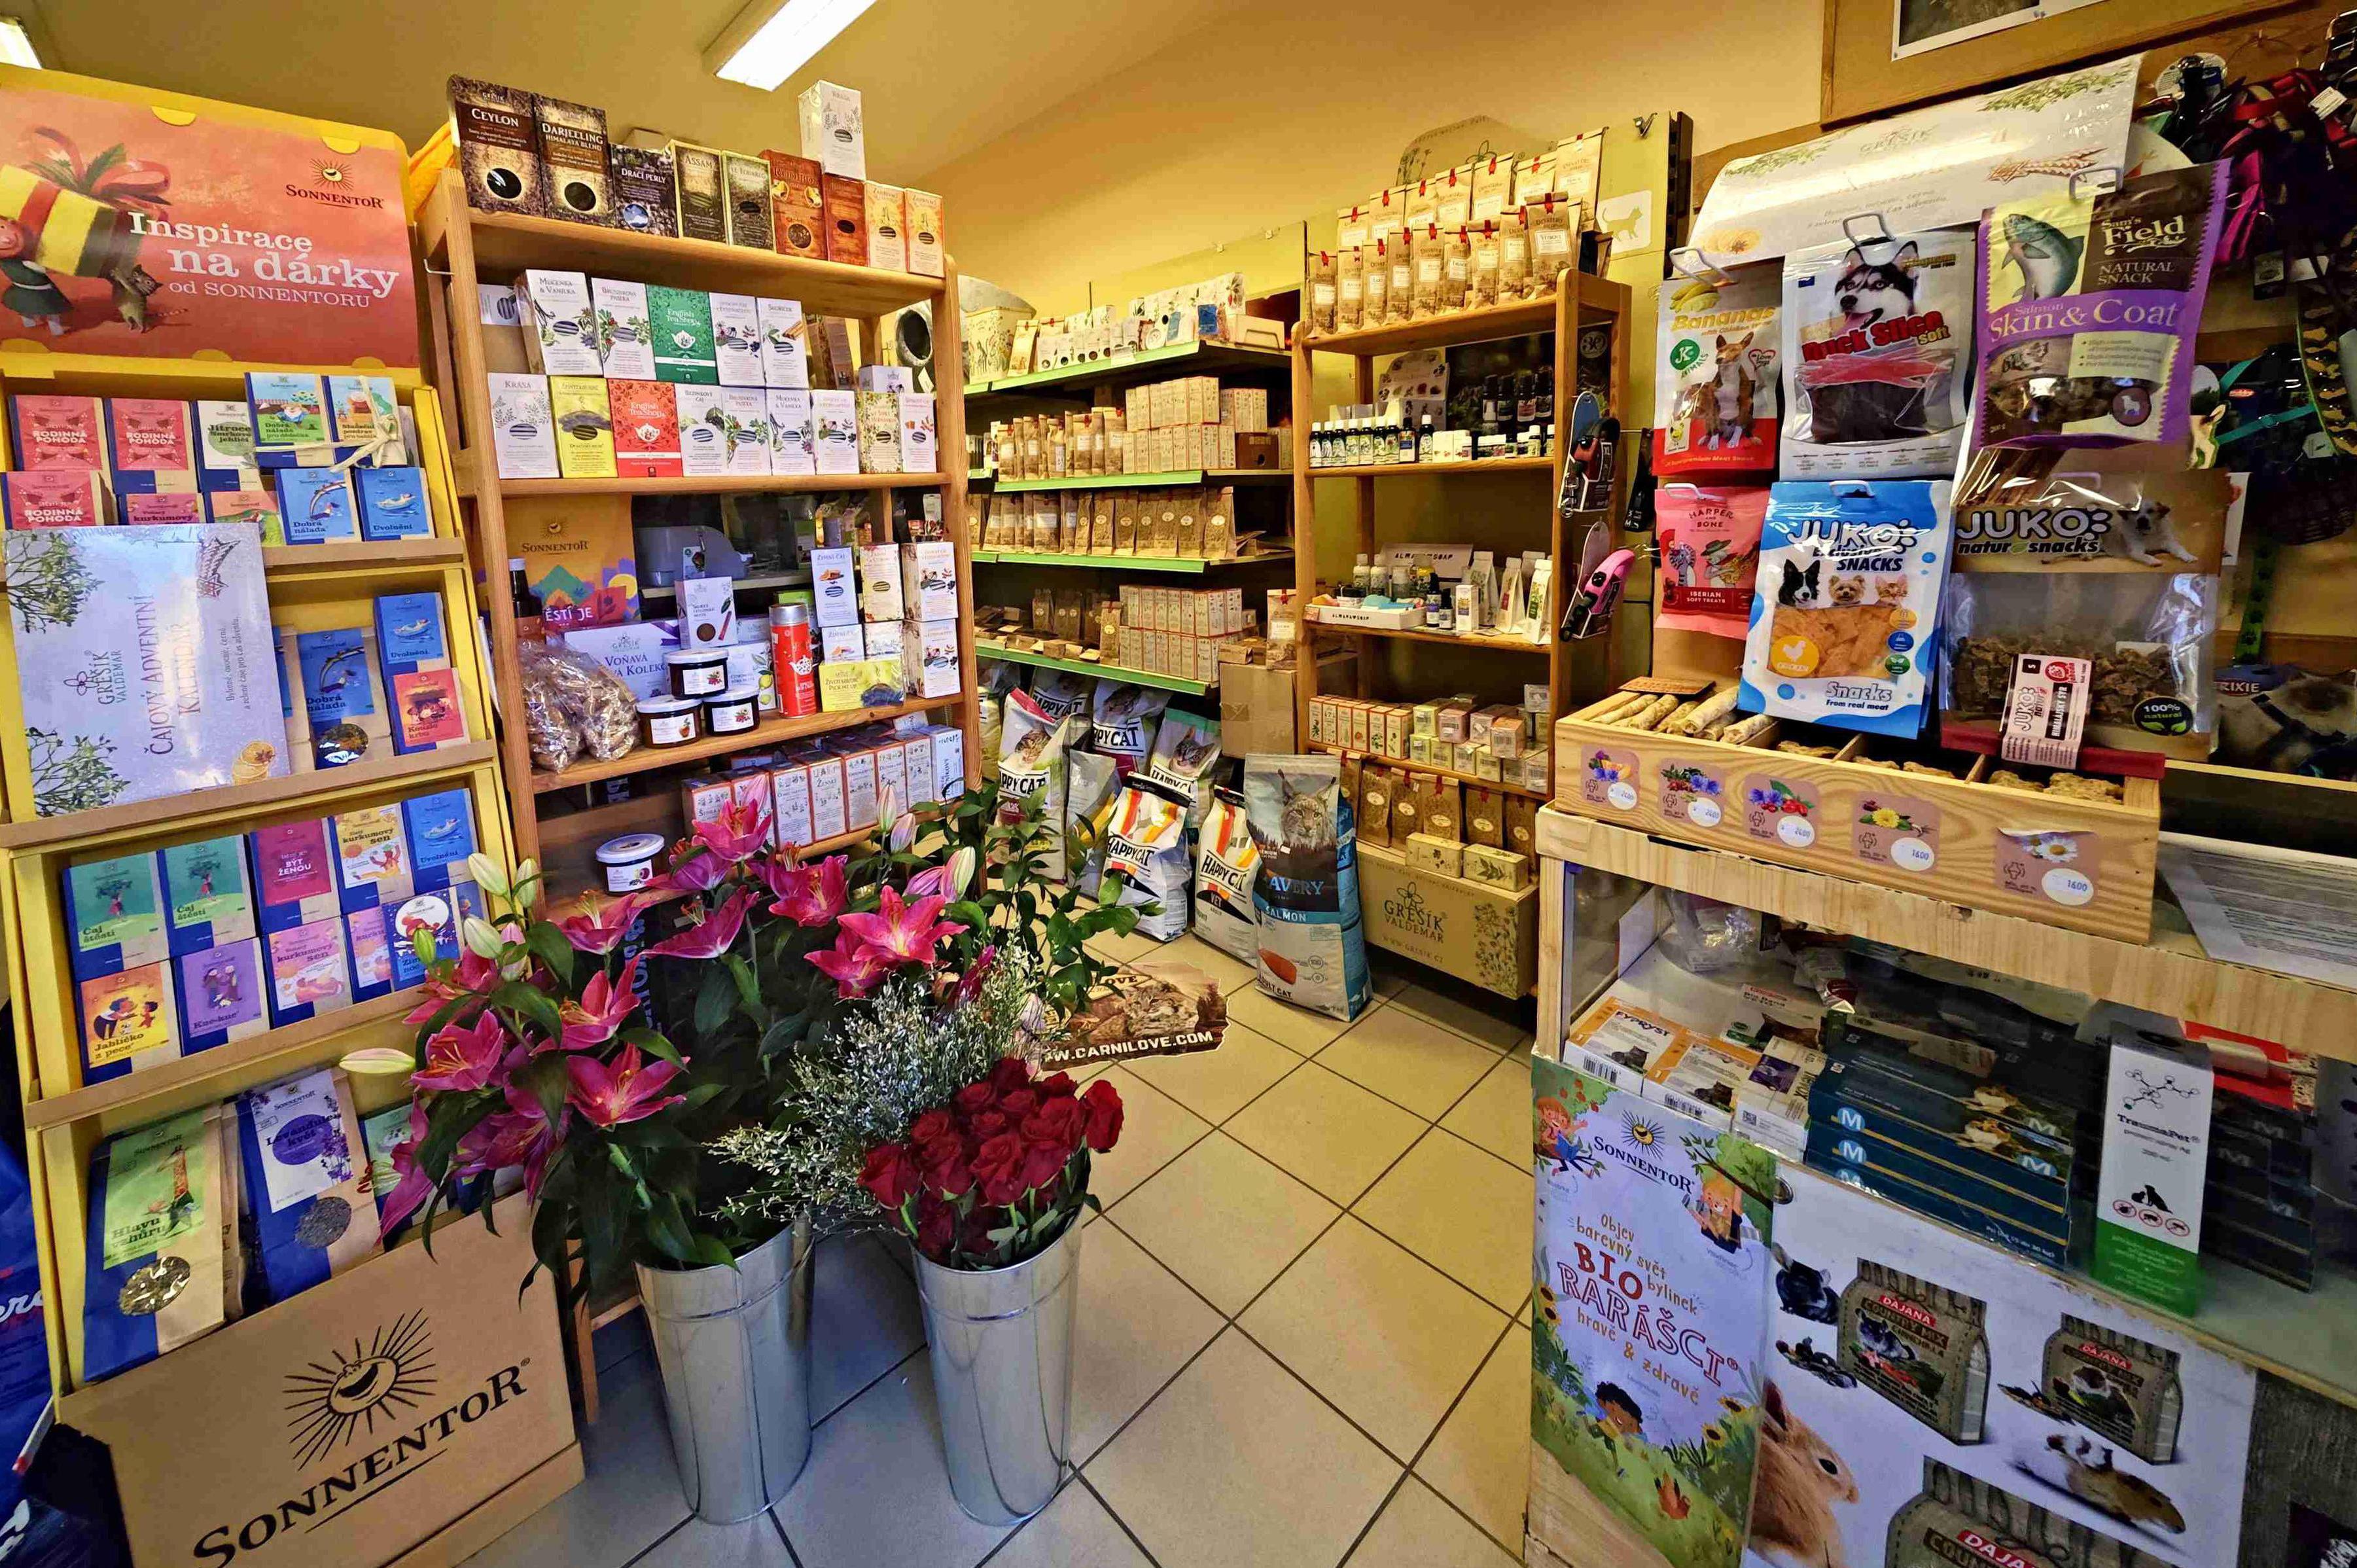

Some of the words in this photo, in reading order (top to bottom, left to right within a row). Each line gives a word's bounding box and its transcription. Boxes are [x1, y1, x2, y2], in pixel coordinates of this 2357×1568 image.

[472, 108, 518, 127] CEYLON
[542, 123, 603, 145] DARJEELING
[685, 155, 713, 168] ASSAM
[128, 211, 312, 252] Inspirace
[2100, 214, 2142, 229] Sam's
[2104, 215, 2187, 247] Field
[168, 249, 239, 277] na
[254, 248, 399, 297] dárky
[2099, 260, 2175, 275] NATURAL
[2097, 272, 2153, 285] SNACK
[169, 282, 197, 295] od
[205, 283, 369, 307] SONNENTORU
[2014, 300, 2064, 315] Salmon
[1672, 307, 1775, 332] Bananas
[1989, 309, 2055, 343] Skin
[2059, 306, 2087, 328] &
[2093, 298, 2179, 328] Coat
[1802, 333, 1871, 362] Duck
[1604, 446, 1610, 455] XL
[1689, 508, 1734, 519] HARPER
[1956, 507, 2090, 540] JUKO
[1786, 520, 1903, 549] JUKO
[523, 541, 589, 552] SONNENTOR
[1836, 558, 1902, 571] SNACKS
[546, 605, 572, 621] ĚSTÍ
[578, 607, 594, 620] JE
[130, 594, 164, 683] ADVENTNÍ
[605, 652, 648, 667] VOŇAVÁ
[627, 663, 667, 676] KOLEKC
[111, 650, 127, 704] VALDEMAR
[306, 694, 342, 704] Dobrá
[1826, 681, 1892, 702] Snacks
[2013, 692, 2035, 731] JUKO
[2143, 703, 2181, 713] 100%
[2144, 711, 2182, 719] natural
[144, 692, 173, 755] ČAJOVÝ
[1111, 726, 1139, 747] CAT
[342, 827, 394, 844] kurkumový
[370, 835, 391, 844] sen
[278, 863, 311, 876] ŽENOU
[1201, 855, 1226, 879] HAPPY
[1228, 870, 1247, 891] CAT
[1268, 876, 1324, 896] AVERY
[1211, 894, 1222, 906] VET
[1266, 906, 1307, 922] SALMON
[1385, 915, 1444, 944] VALDEMAR
[1277, 988, 1293, 998] CAT
[1616, 1010, 1671, 1037] FYPRYST
[1045, 1031, 1213, 1063] W.CARNILOVE.COM
[1841, 1111, 1863, 1132] M
[1842, 1143, 1864, 1164] M
[1593, 1135, 1695, 1194] SONNENTOR
[2023, 1156, 2053, 1177] M
[112, 1216, 160, 1239] Hlavu
[1600, 1213, 1635, 1243] Objev
[1576, 1216, 1633, 1262] barevný
[1637, 1254, 1667, 1280] svět
[1573, 1241, 1644, 1300] BIO
[1647, 1274, 1699, 1317] bylinek
[1881, 1297, 1931, 1325] DAJANA
[1576, 1308, 1616, 1343] hravě
[1623, 1340, 1635, 1361] &
[1642, 1357, 1699, 1406] zdravě
[2082, 1344, 2127, 1368] DAJANA
[1964, 1534, 2027, 1568] DAJA
